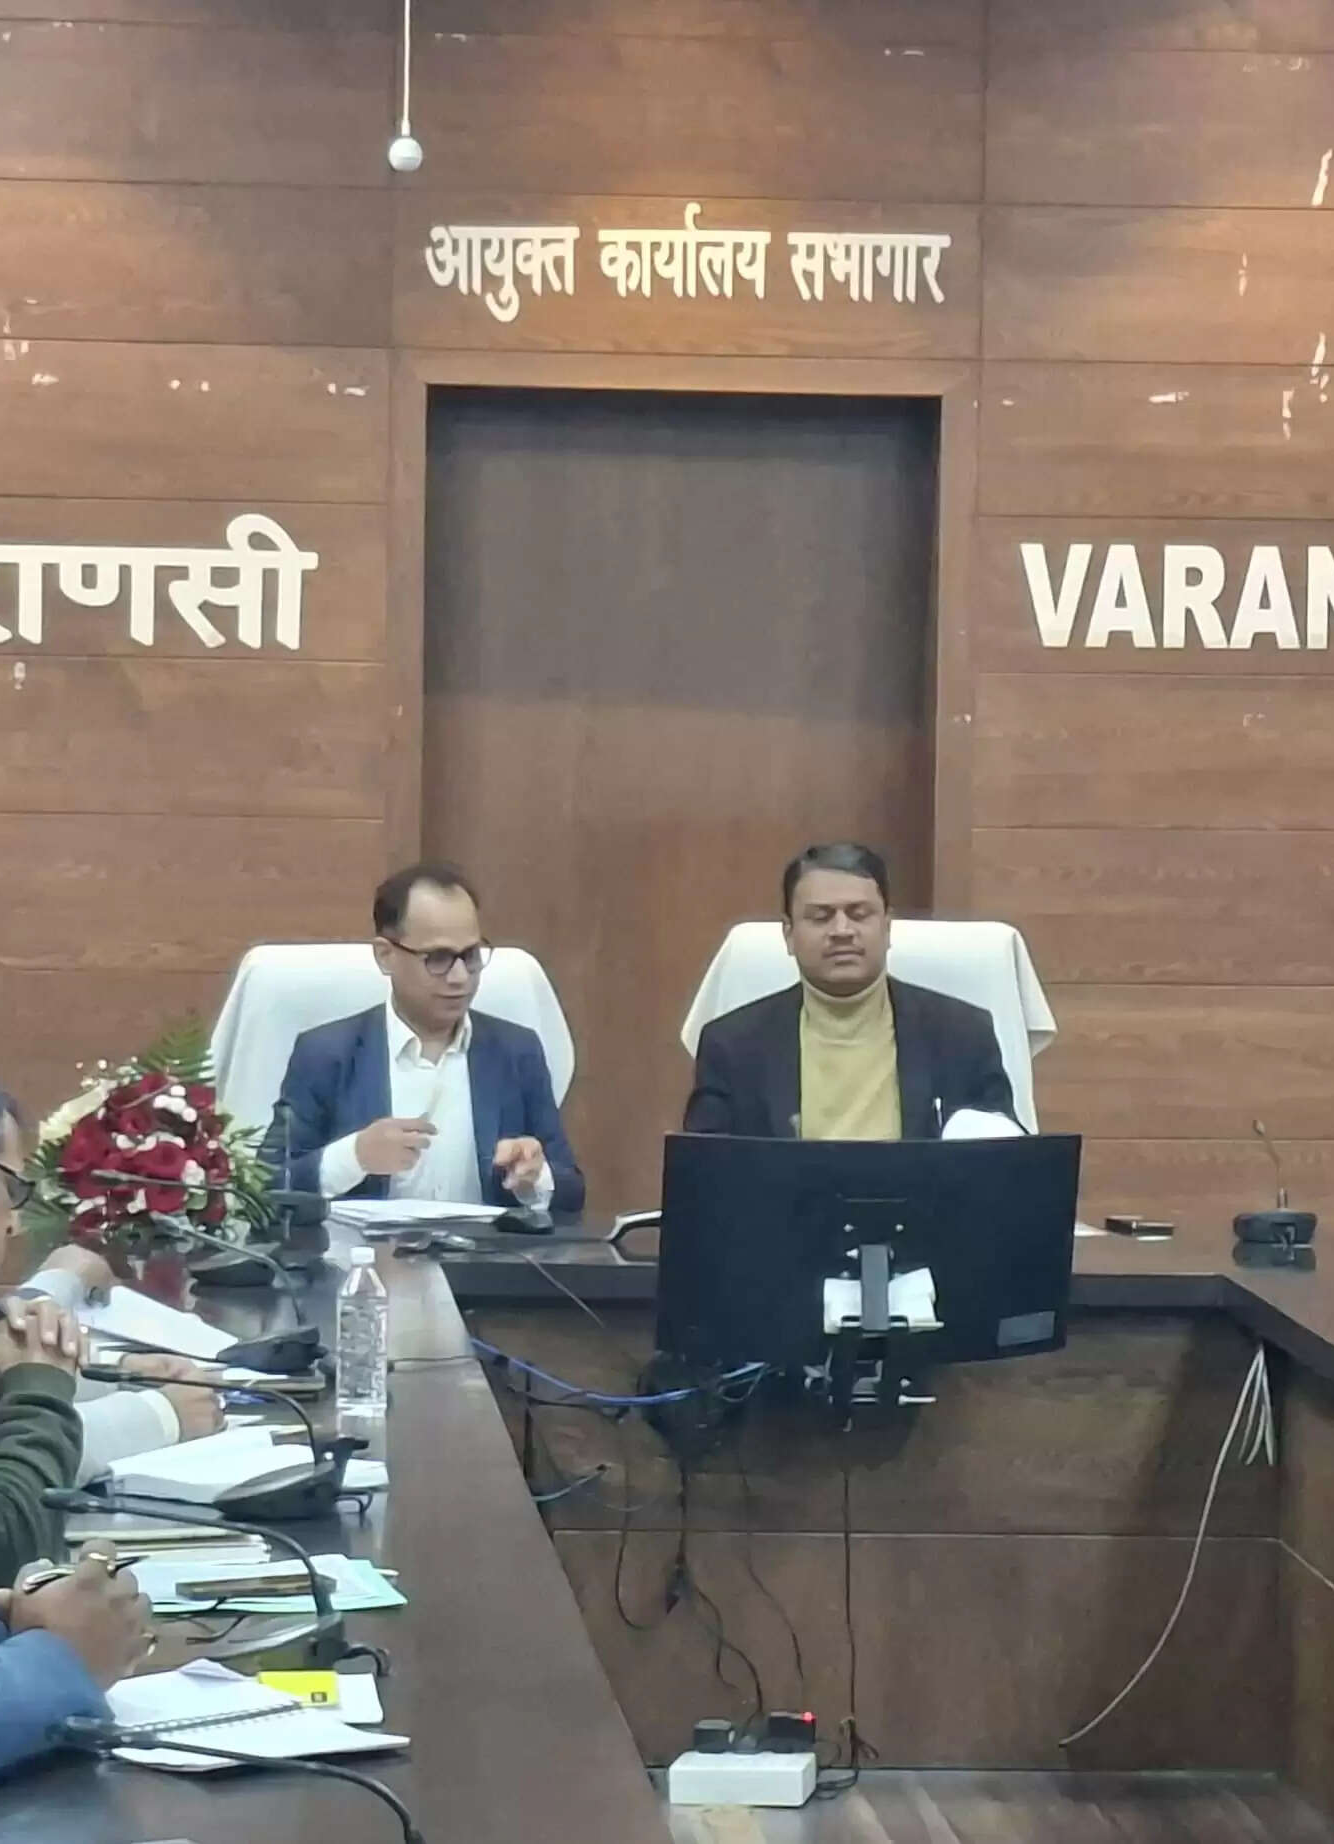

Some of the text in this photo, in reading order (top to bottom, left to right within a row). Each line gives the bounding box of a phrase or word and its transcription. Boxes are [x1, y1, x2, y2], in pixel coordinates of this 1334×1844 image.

[425, 202, 952, 322] आयुक्त कार्यालय सभागार
